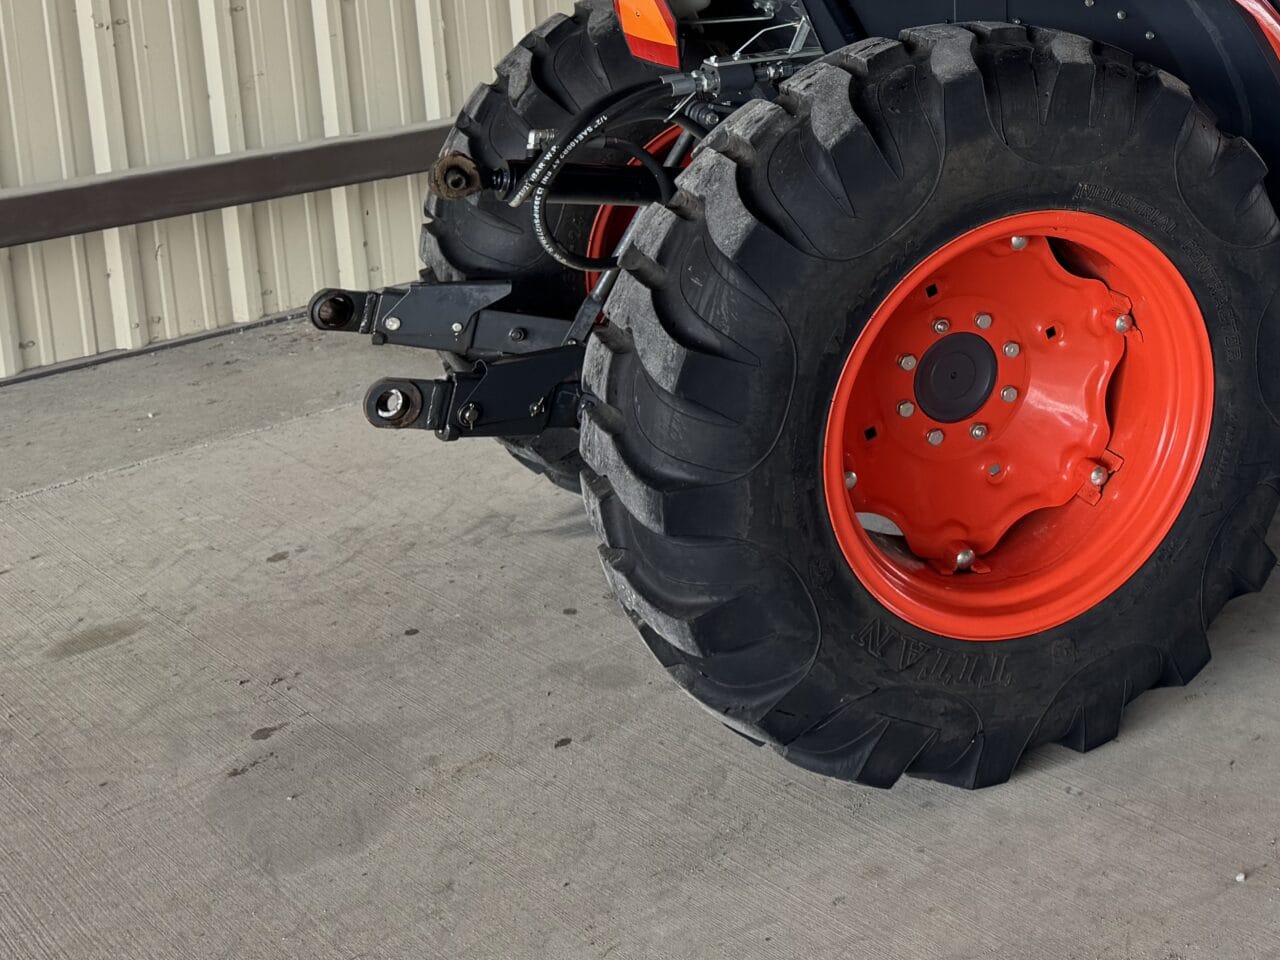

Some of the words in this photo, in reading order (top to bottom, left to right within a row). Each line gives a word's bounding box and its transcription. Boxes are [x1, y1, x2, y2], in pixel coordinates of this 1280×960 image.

[1072, 182, 1177, 240] INDUSTRIAL
[1180, 239, 1243, 363] CONTRACTOR
[851, 617, 1018, 689] TITAN
